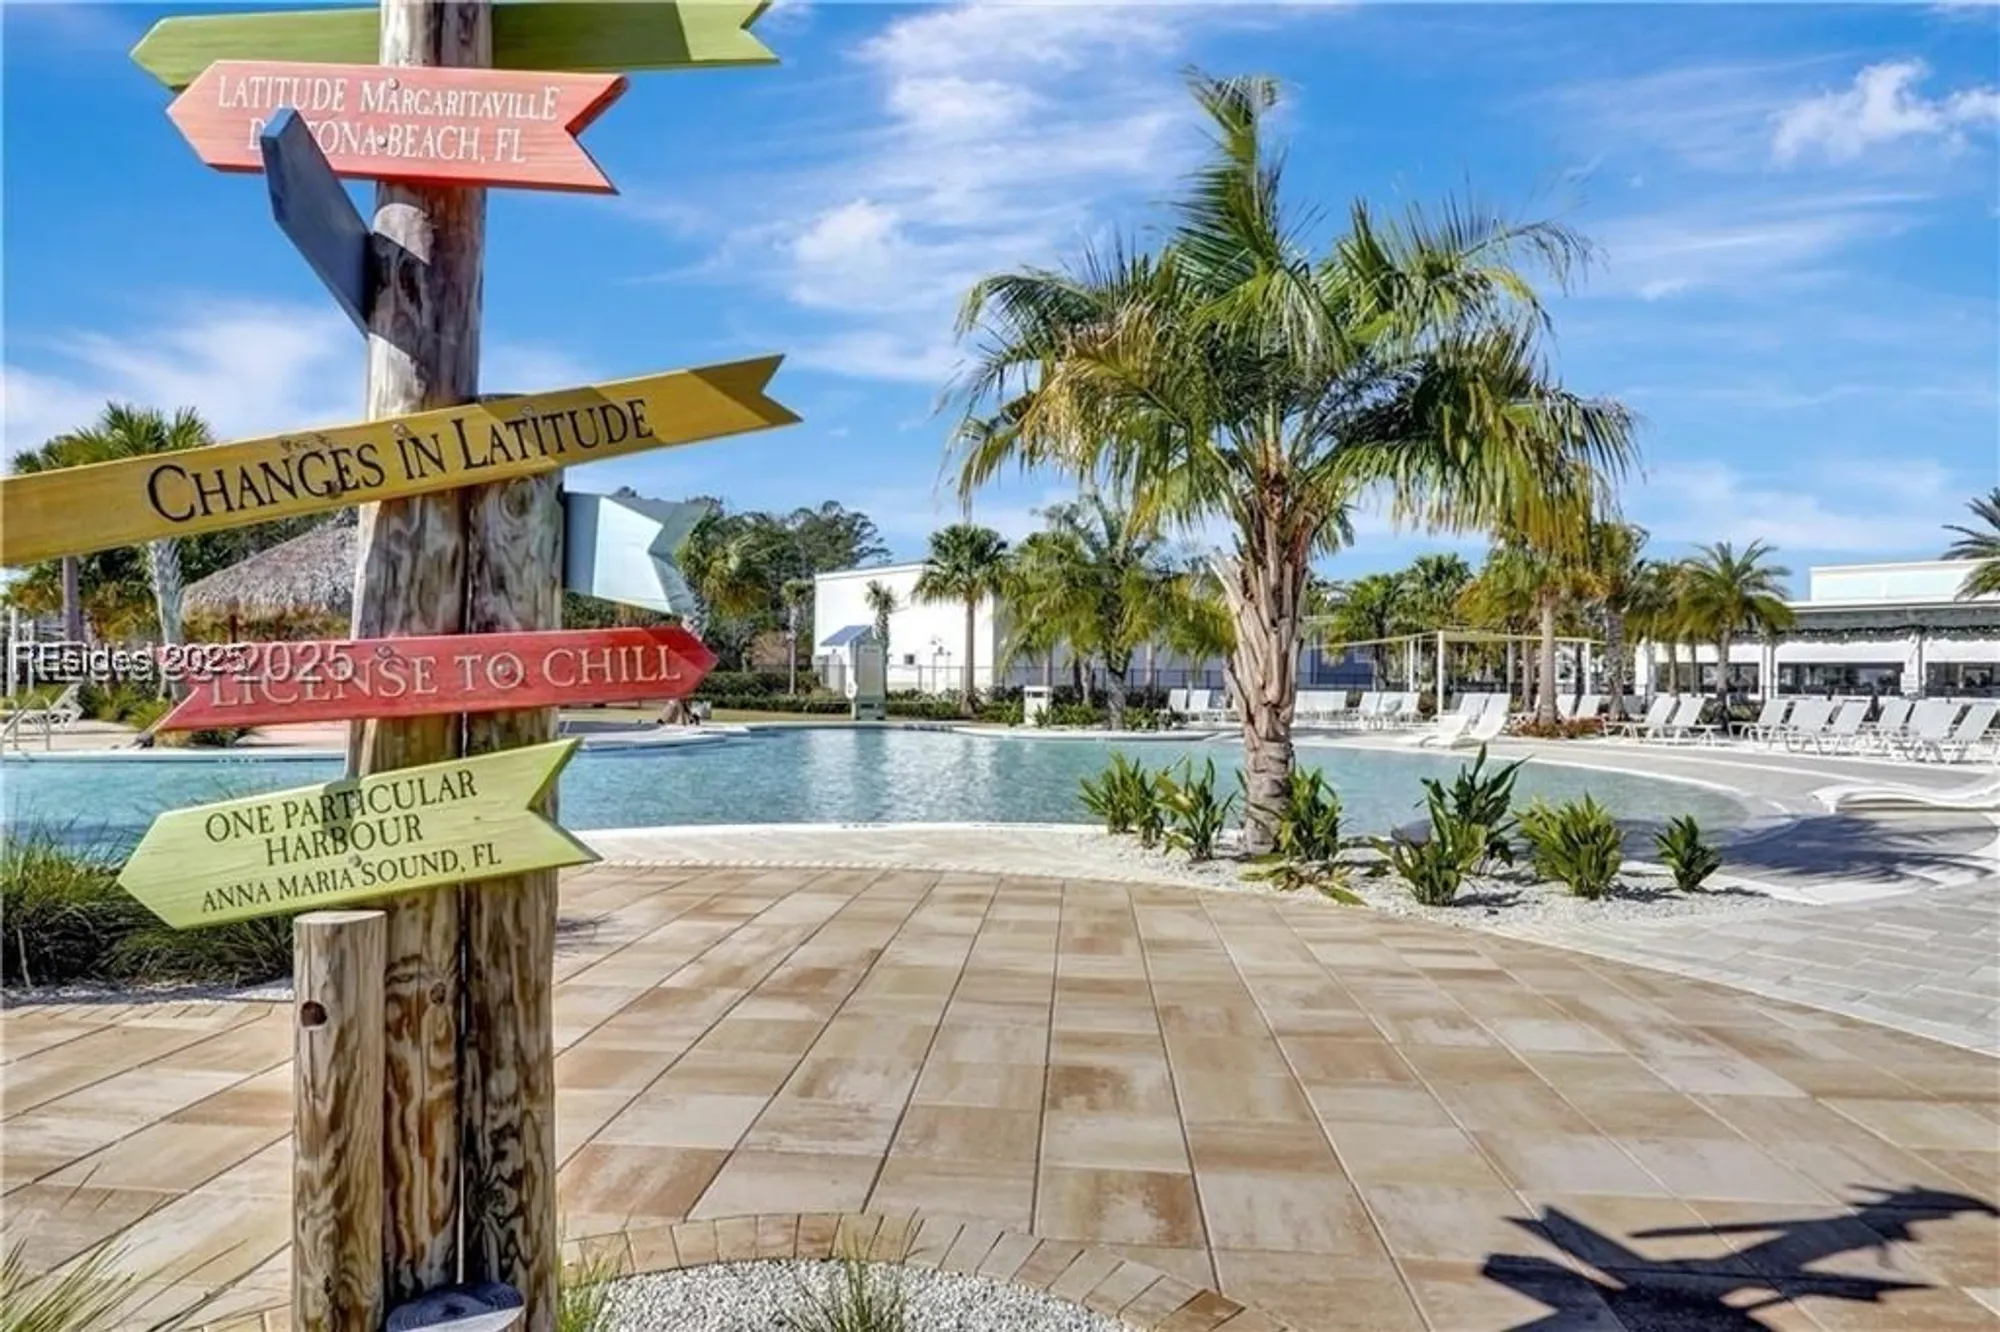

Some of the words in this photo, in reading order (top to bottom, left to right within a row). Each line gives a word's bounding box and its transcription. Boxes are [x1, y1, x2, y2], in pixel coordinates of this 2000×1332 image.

[218, 74, 346, 110] LATITUDE
[361, 82, 559, 119] MARGARITAVILLE
[387, 124, 486, 162] BEACH,
[494, 128, 526, 164] FL
[147, 442, 385, 523] CHANGES
[398, 432, 445, 480] IN
[451, 399, 653, 470] LATITUDE
[445, 654, 524, 691] TO
[558, 645, 681, 686] CHILL
[205, 804, 275, 843] ONE
[285, 768, 477, 830] PARTICULAR
[266, 814, 423, 866] HARBOUR
[201, 877, 271, 913] ANNA
[279, 867, 355, 902] MARIA
[361, 853, 466, 887] SOUND,
[473, 844, 501, 867] FL
